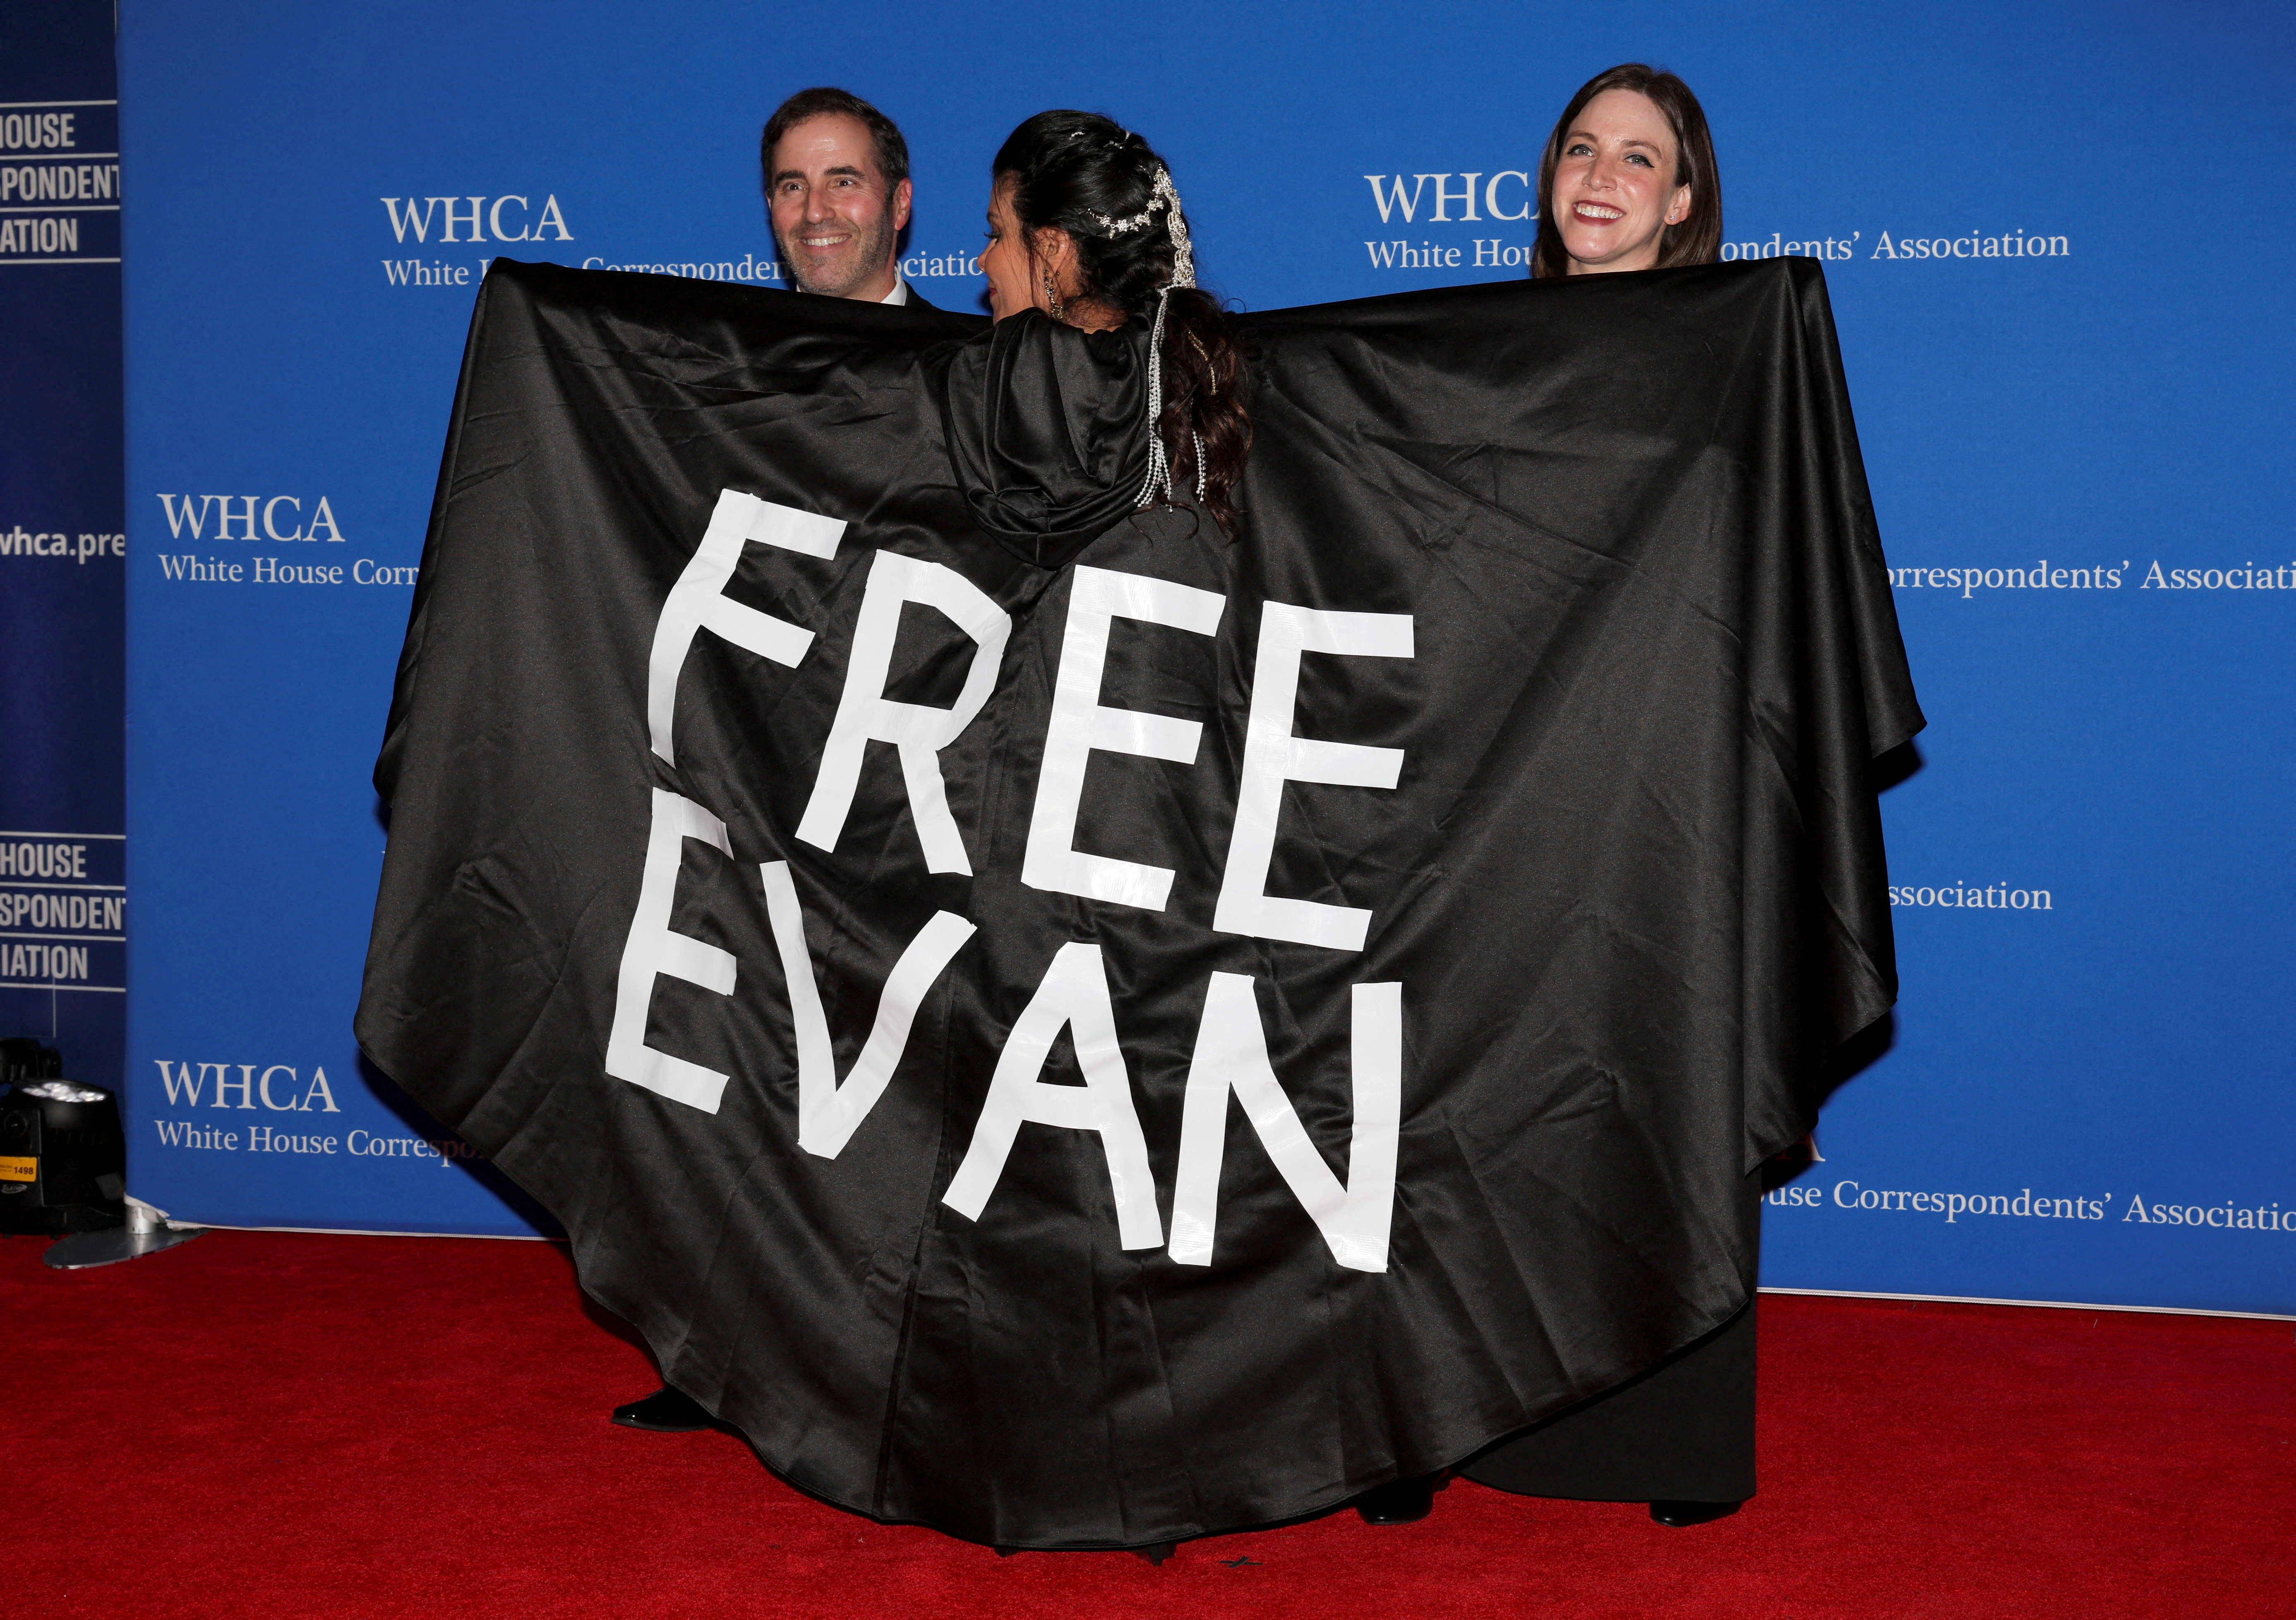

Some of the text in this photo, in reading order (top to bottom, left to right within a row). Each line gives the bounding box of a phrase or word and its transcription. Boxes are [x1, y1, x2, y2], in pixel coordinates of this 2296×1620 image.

[0, 113, 75, 149] OUSE
[1363, 170, 1540, 223] WHC
[0, 218, 77, 252] ATION
[380, 194, 574, 243] WHCA
[1364, 240, 1461, 268] White
[1870, 229, 2070, 259] Association
[381, 259, 469, 285] White
[156, 494, 345, 542] WHCA
[158, 555, 419, 585] White House Corr
[648, 489, 1415, 951] FREE
[0, 843, 86, 878] HOUSE
[0, 893, 126, 930] SPONDEN
[1888, 879, 2053, 910] ssociation
[2, 944, 87, 979] IATION
[605, 787, 1402, 1273] EVAN
[154, 1060, 341, 1112] WHCA
[155, 1120, 238, 1150] White
[248, 1126, 337, 1154] House
[14, 1166, 34, 1174] 1498
[1760, 1184, 1821, 1207] use
[1834, 1181, 2111, 1223] Correspondents’
